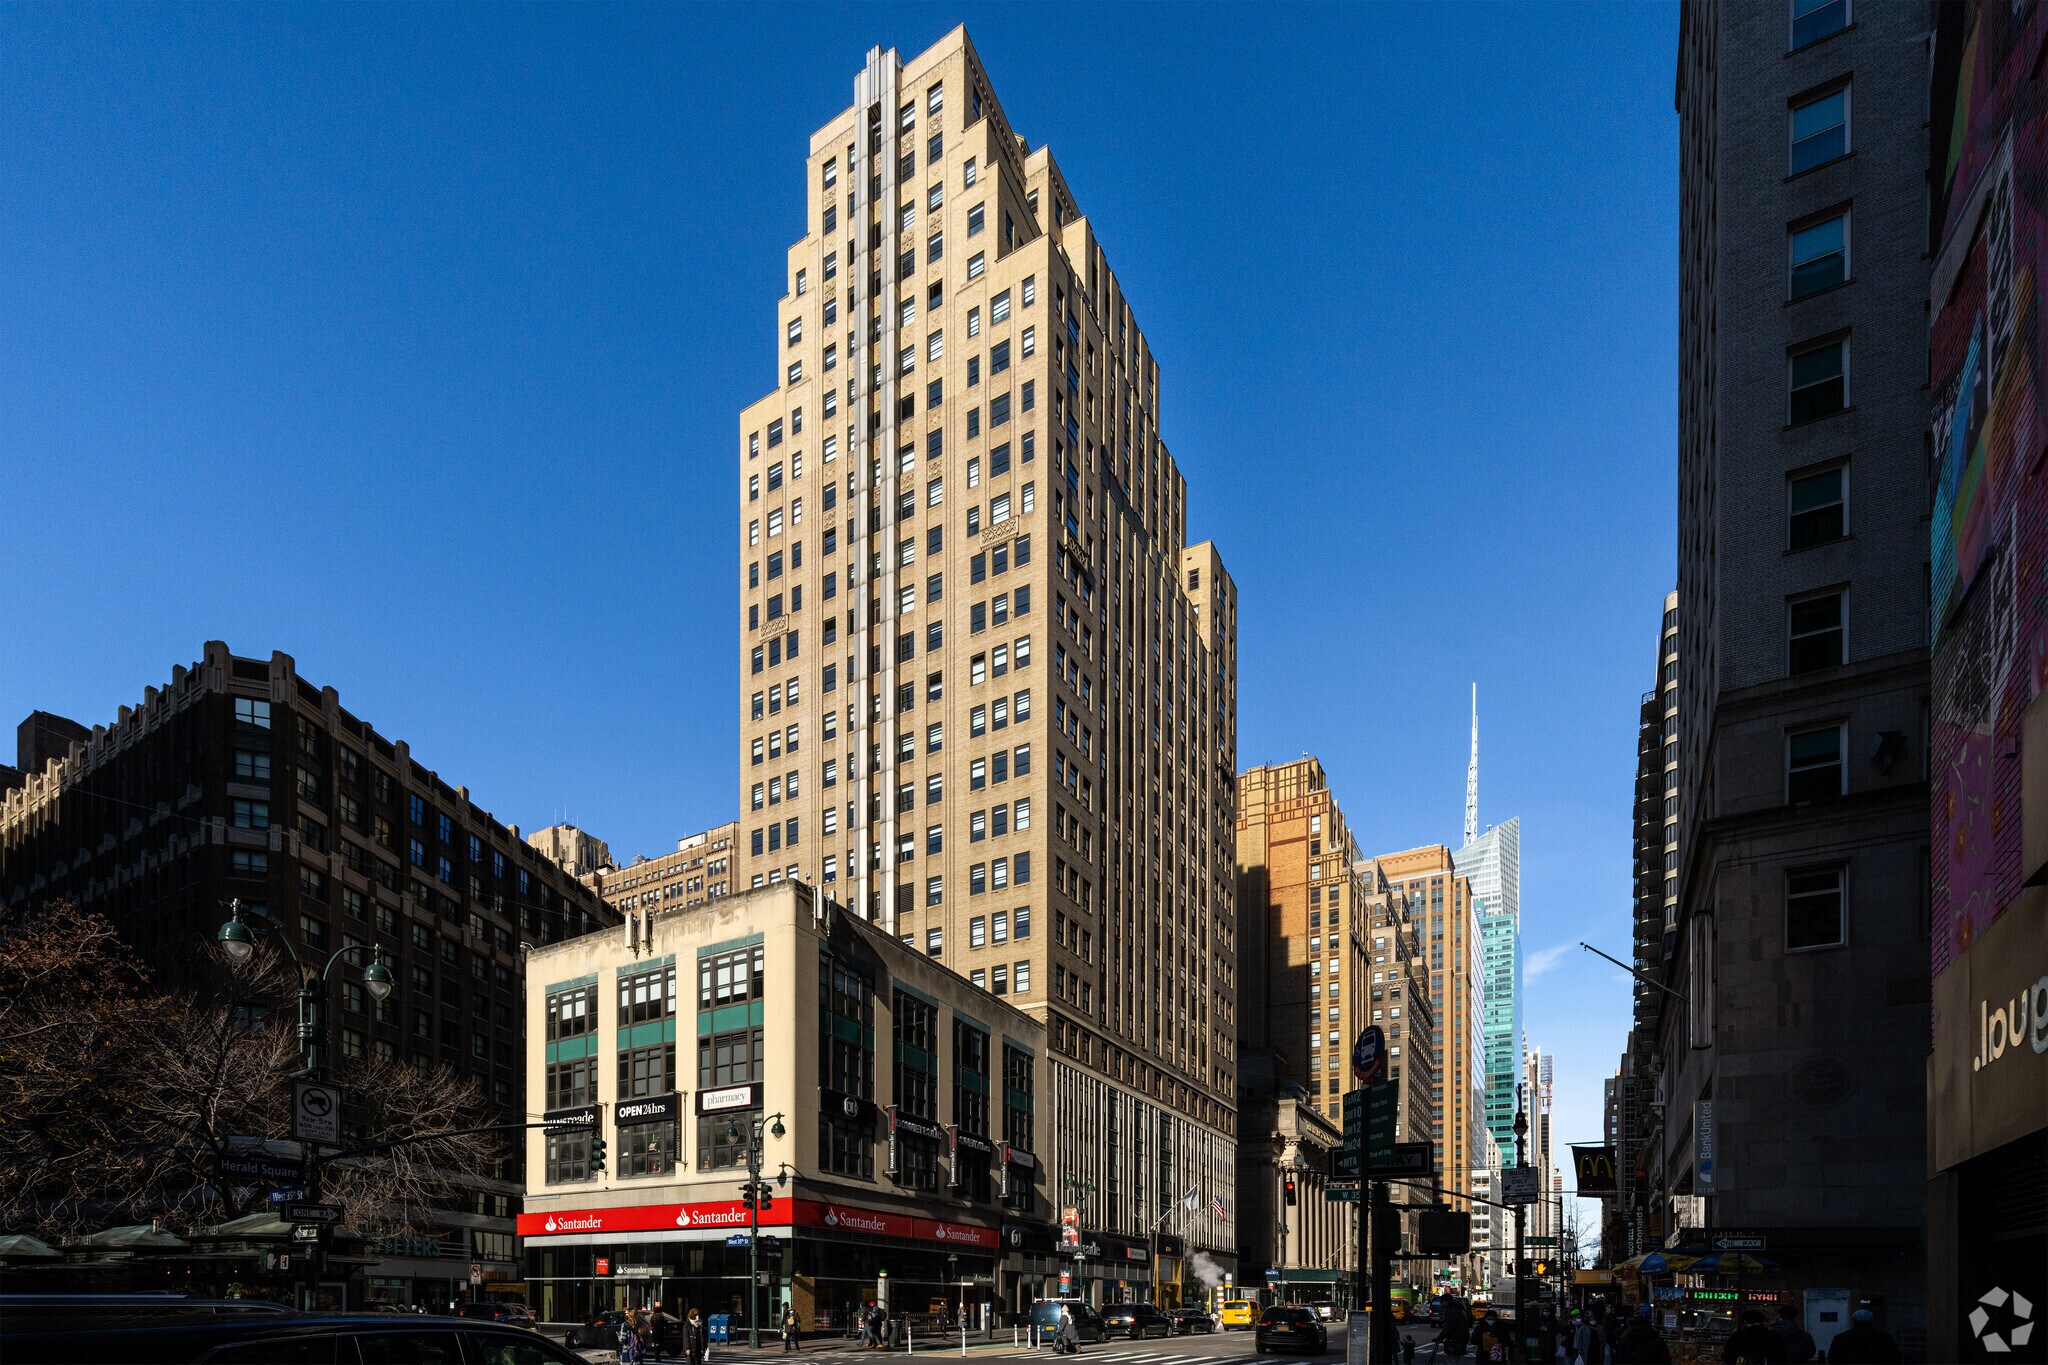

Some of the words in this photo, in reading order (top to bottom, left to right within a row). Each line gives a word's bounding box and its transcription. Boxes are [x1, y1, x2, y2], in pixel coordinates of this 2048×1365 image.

[707, 1092, 746, 1108] pharmacy
[619, 1105, 642, 1118] OPEN
[1700, 1102, 1712, 1159] BankUnited
[221, 1160, 258, 1174] Herald
[261, 1164, 298, 1179] Square
[1344, 1156, 1357, 1168] MTA
[272, 1192, 286, 1201] West
[286, 1190, 296, 1200] 35th
[297, 1189, 304, 1200] St
[1342, 1191, 1349, 1199] W
[297, 1209, 312, 1217] ONE
[692, 1207, 746, 1225] Santander
[558, 1214, 602, 1230] Santander
[840, 1212, 886, 1231] Santander
[946, 1226, 981, 1243] Santander
